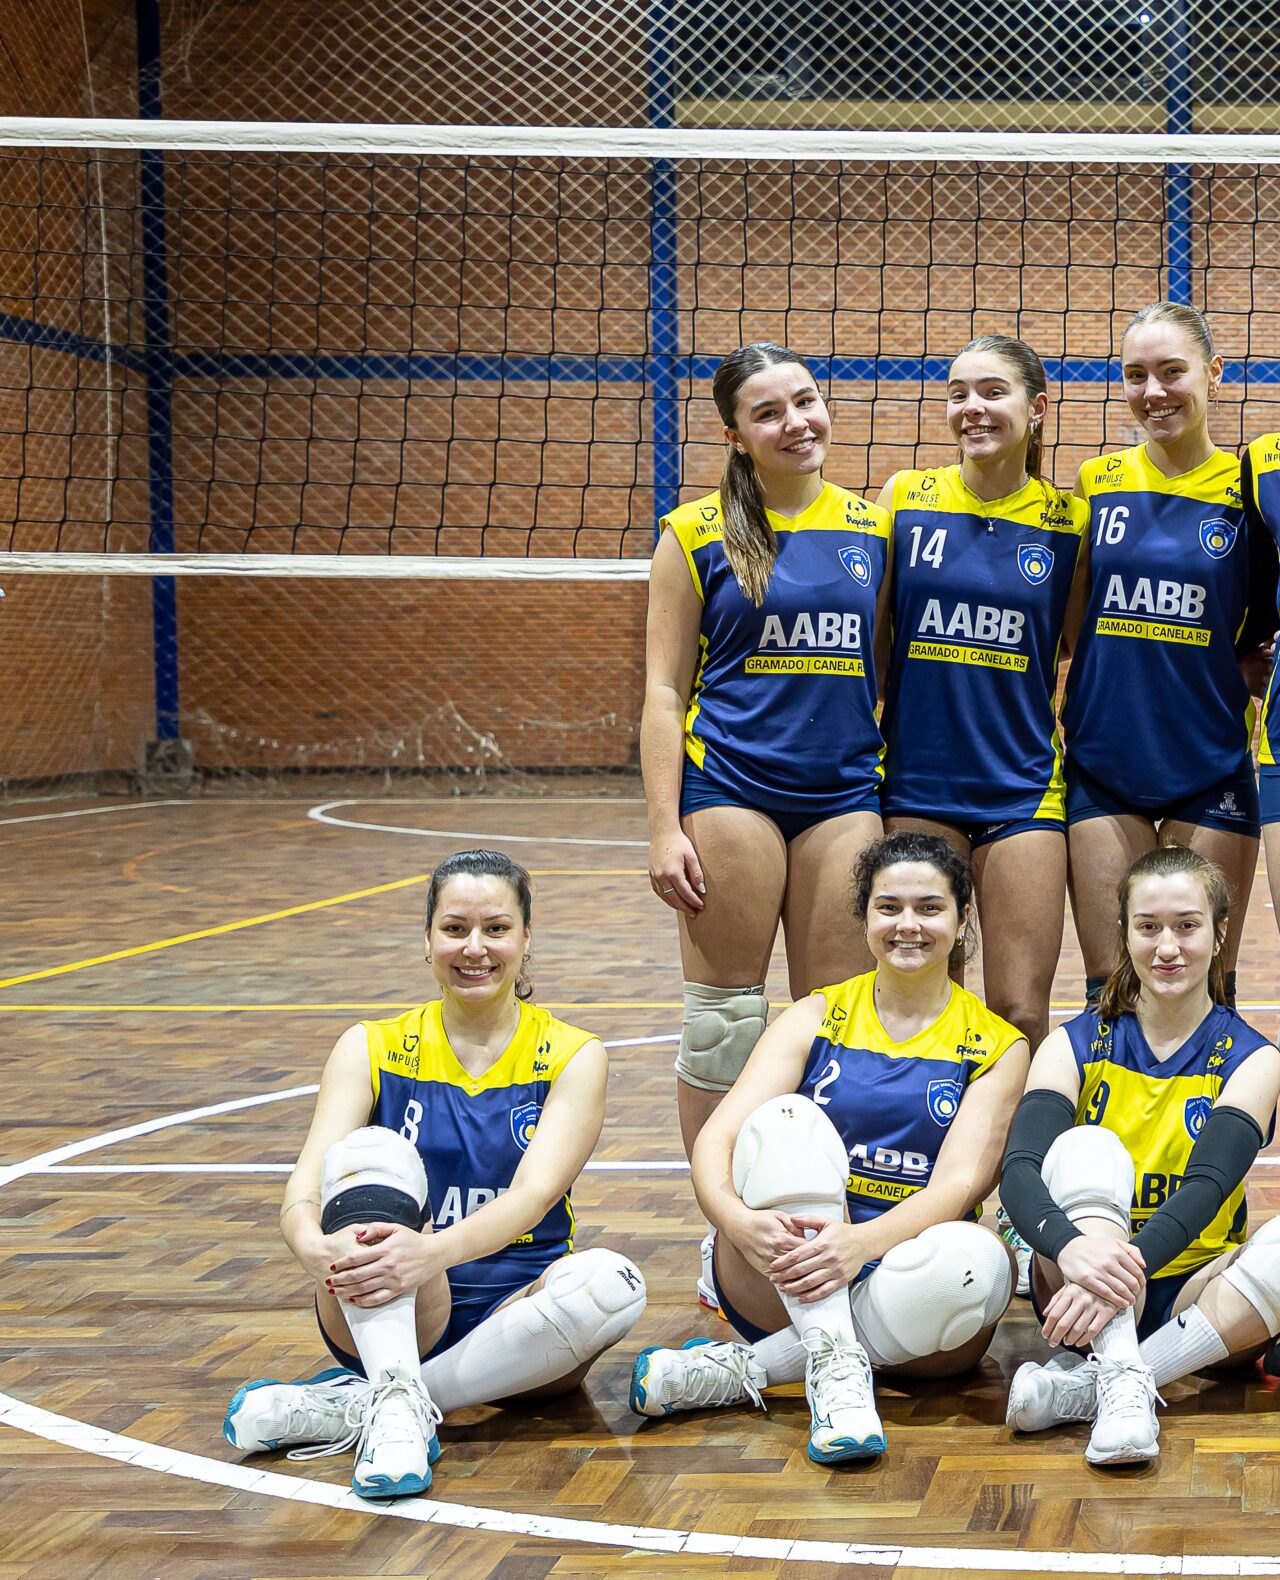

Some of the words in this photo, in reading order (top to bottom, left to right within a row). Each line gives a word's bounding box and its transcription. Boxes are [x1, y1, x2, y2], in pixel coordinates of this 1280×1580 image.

[696, 522, 723, 537] INPUL
[1096, 506, 1130, 546] 16
[910, 525, 948, 569] 14
[1103, 574, 1207, 619] AABB
[758, 612, 862, 649] AABB
[918, 598, 1026, 644] AABB
[1152, 627, 1194, 641] CANELA
[1195, 631, 1209, 643] RS
[746, 659, 805, 670] GRAMADO
[813, 659, 856, 672] CANELA
[909, 644, 960, 659] GRAMADO
[970, 651, 1012, 667] CANELA
[1013, 656, 1027, 668] RS
[388, 1049, 420, 1068] INPULS
[813, 1059, 841, 1105] 2
[400, 1099, 423, 1145] 8
[1085, 1080, 1111, 1125] 9
